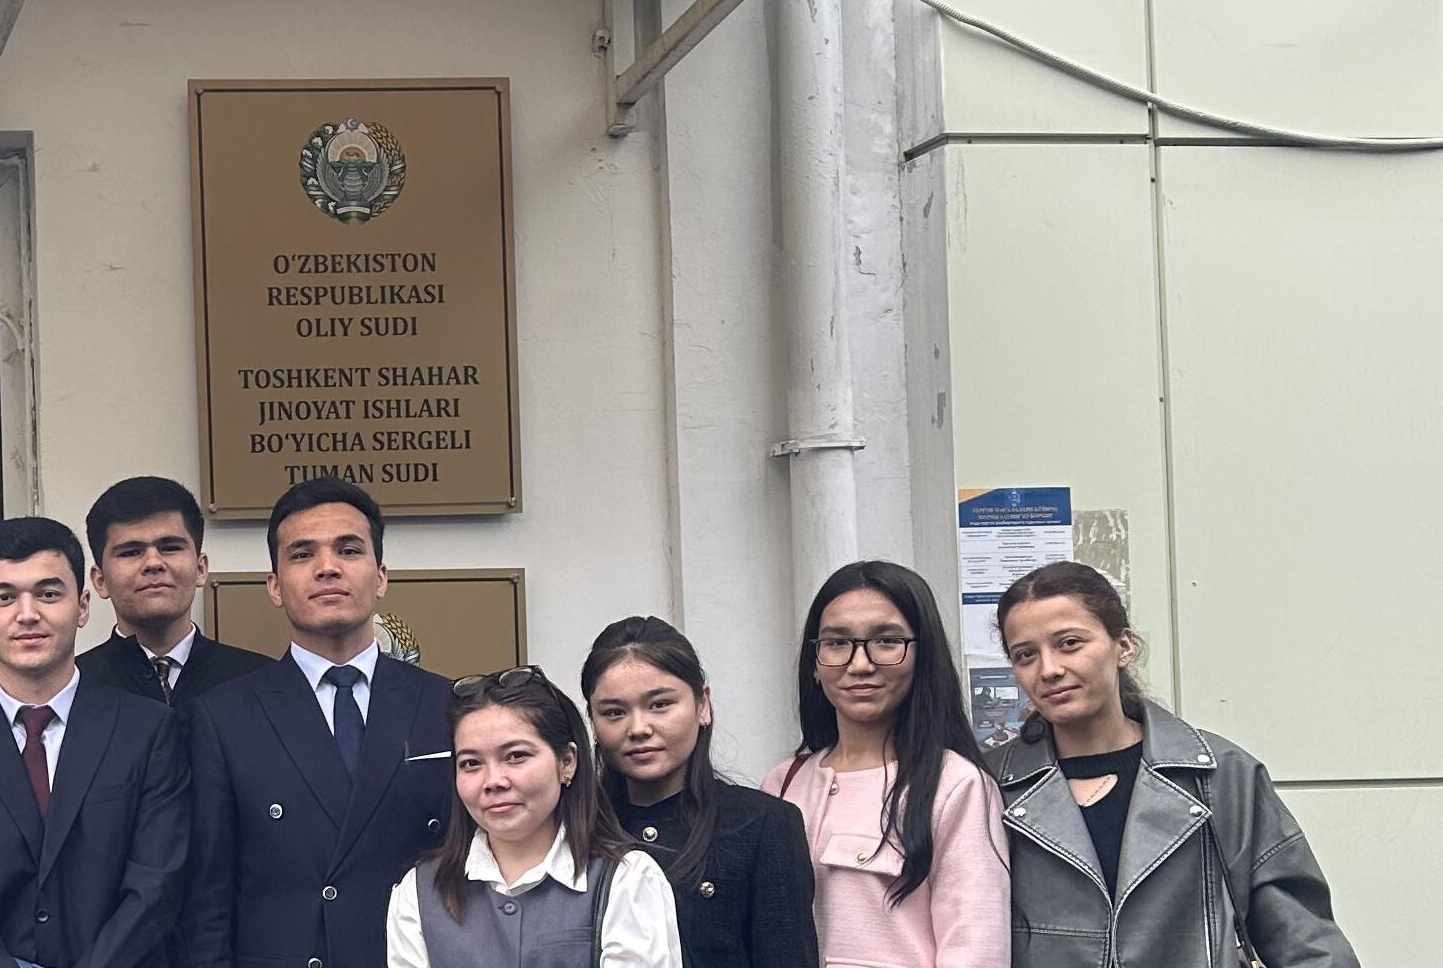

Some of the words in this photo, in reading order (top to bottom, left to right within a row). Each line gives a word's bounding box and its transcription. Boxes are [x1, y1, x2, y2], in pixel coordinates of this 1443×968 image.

[267, 283, 445, 307] RESPUBLIKASI
[295, 317, 354, 338] OLIY
[359, 316, 418, 337] SUDI
[237, 366, 371, 390] TOSHKENT
[377, 365, 480, 387] SHAHAR
[258, 399, 355, 427] JINOYAT
[361, 397, 461, 420] ISHLARI
[371, 429, 472, 452] SERGELI
[381, 462, 440, 483] SUDI
